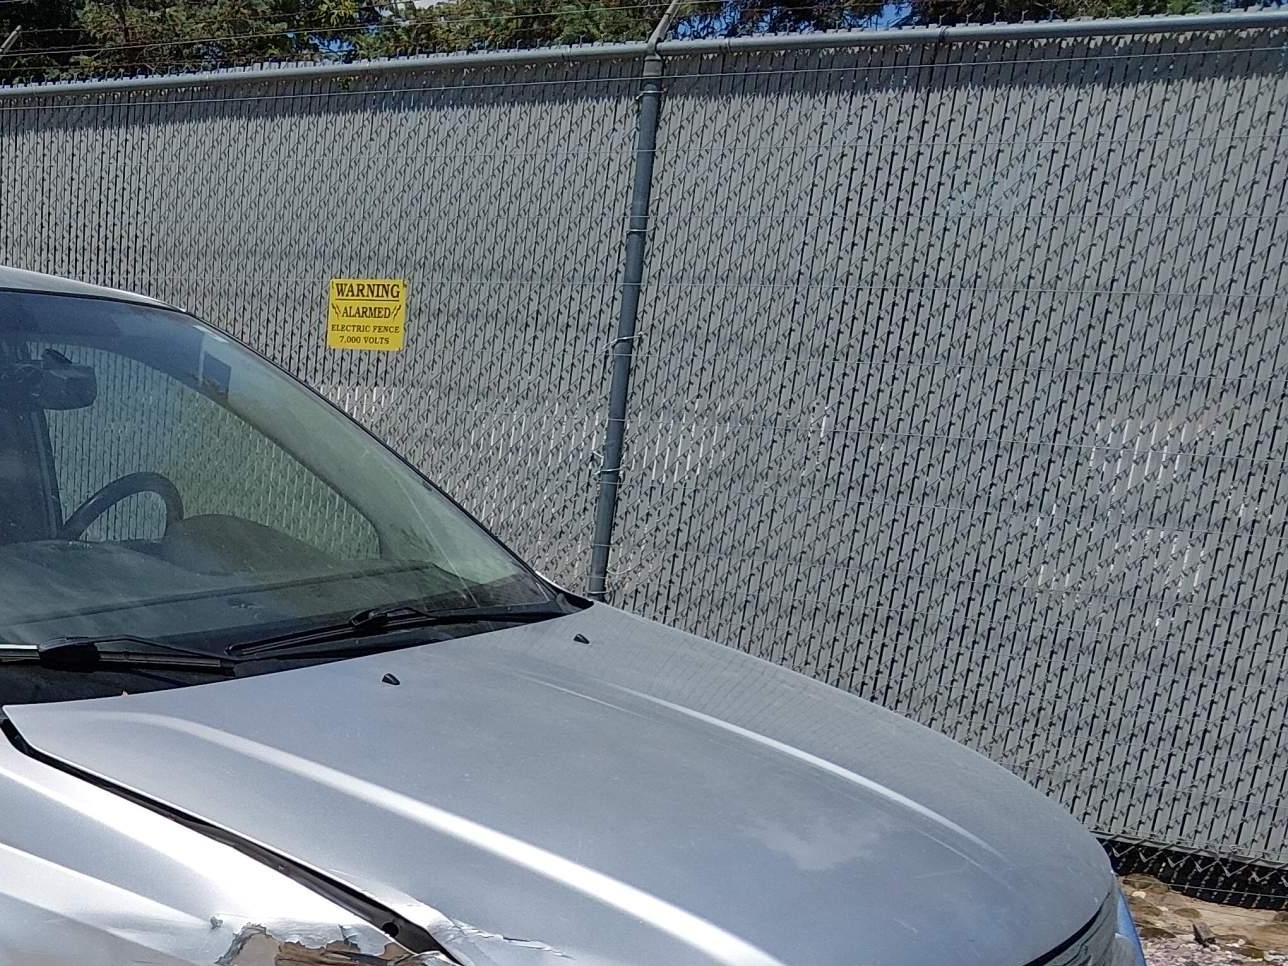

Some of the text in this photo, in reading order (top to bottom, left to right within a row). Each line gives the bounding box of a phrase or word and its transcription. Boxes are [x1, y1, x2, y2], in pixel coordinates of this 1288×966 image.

[335, 283, 400, 298] WARNING
[341, 306, 391, 319] ALARMED
[331, 324, 400, 334] ELECTRIC FENCE
[363, 336, 390, 345] VOLTS
